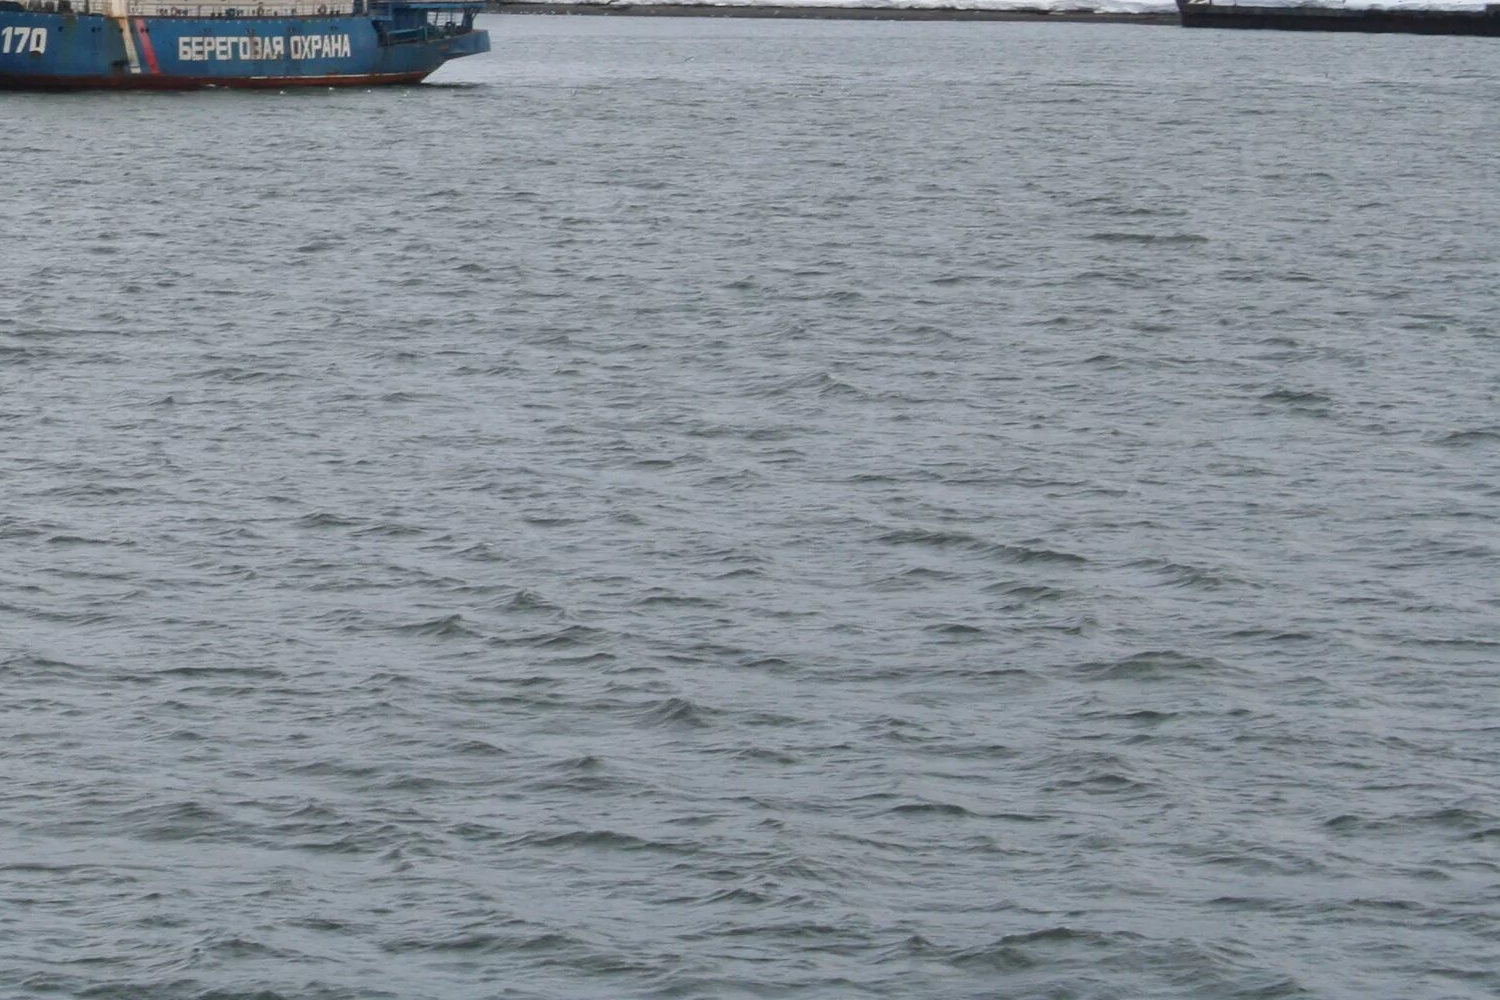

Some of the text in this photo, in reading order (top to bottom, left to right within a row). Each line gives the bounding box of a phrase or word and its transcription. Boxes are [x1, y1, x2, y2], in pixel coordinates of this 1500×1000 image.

[1, 26, 48, 54] 170
[178, 34, 351, 61] БЕРЕГОВАЯ ОХРАНА
